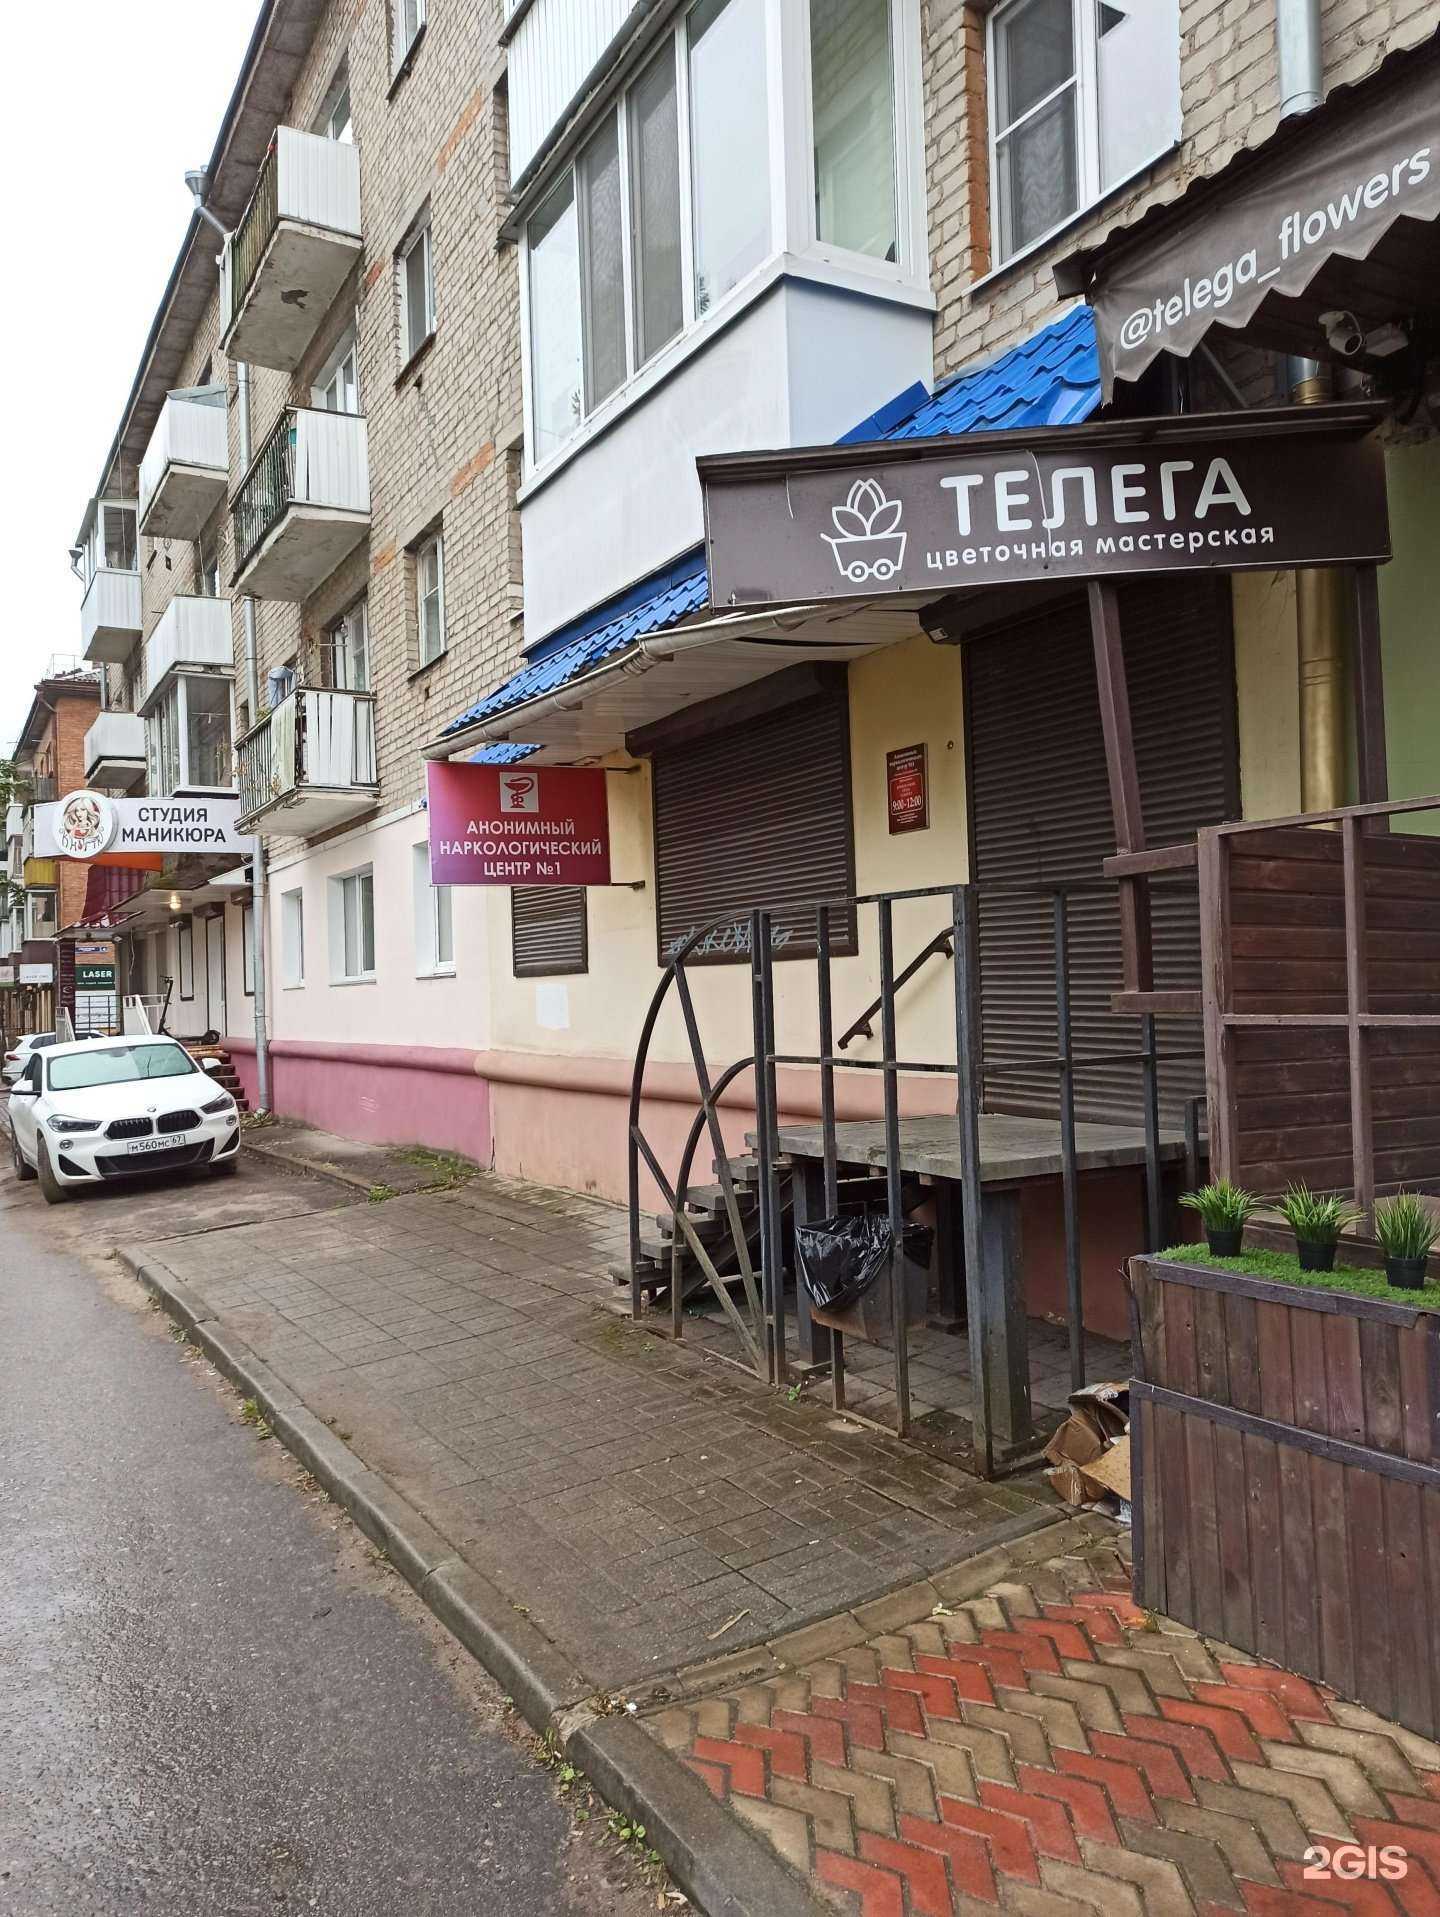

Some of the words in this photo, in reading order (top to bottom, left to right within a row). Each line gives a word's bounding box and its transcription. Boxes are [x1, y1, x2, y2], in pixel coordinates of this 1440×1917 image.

[1120, 147, 1432, 350] @telega_flowers
[939, 457, 1252, 536] ТЕЛЕГА
[926, 539, 1083, 571] цветочная
[1096, 526, 1275, 554] мастерская
[138, 807, 208, 825] СТУДИЯ
[122, 827, 227, 843] МАНИКЮРА
[466, 818, 575, 835] АНОНИМНЫЙ
[439, 838, 602, 855] НАРКОЛОГИЧЕСКИЙ
[483, 861, 531, 877] ЦЕНТР
[536, 861, 561, 876] №1
[82, 970, 113, 978] LASER
